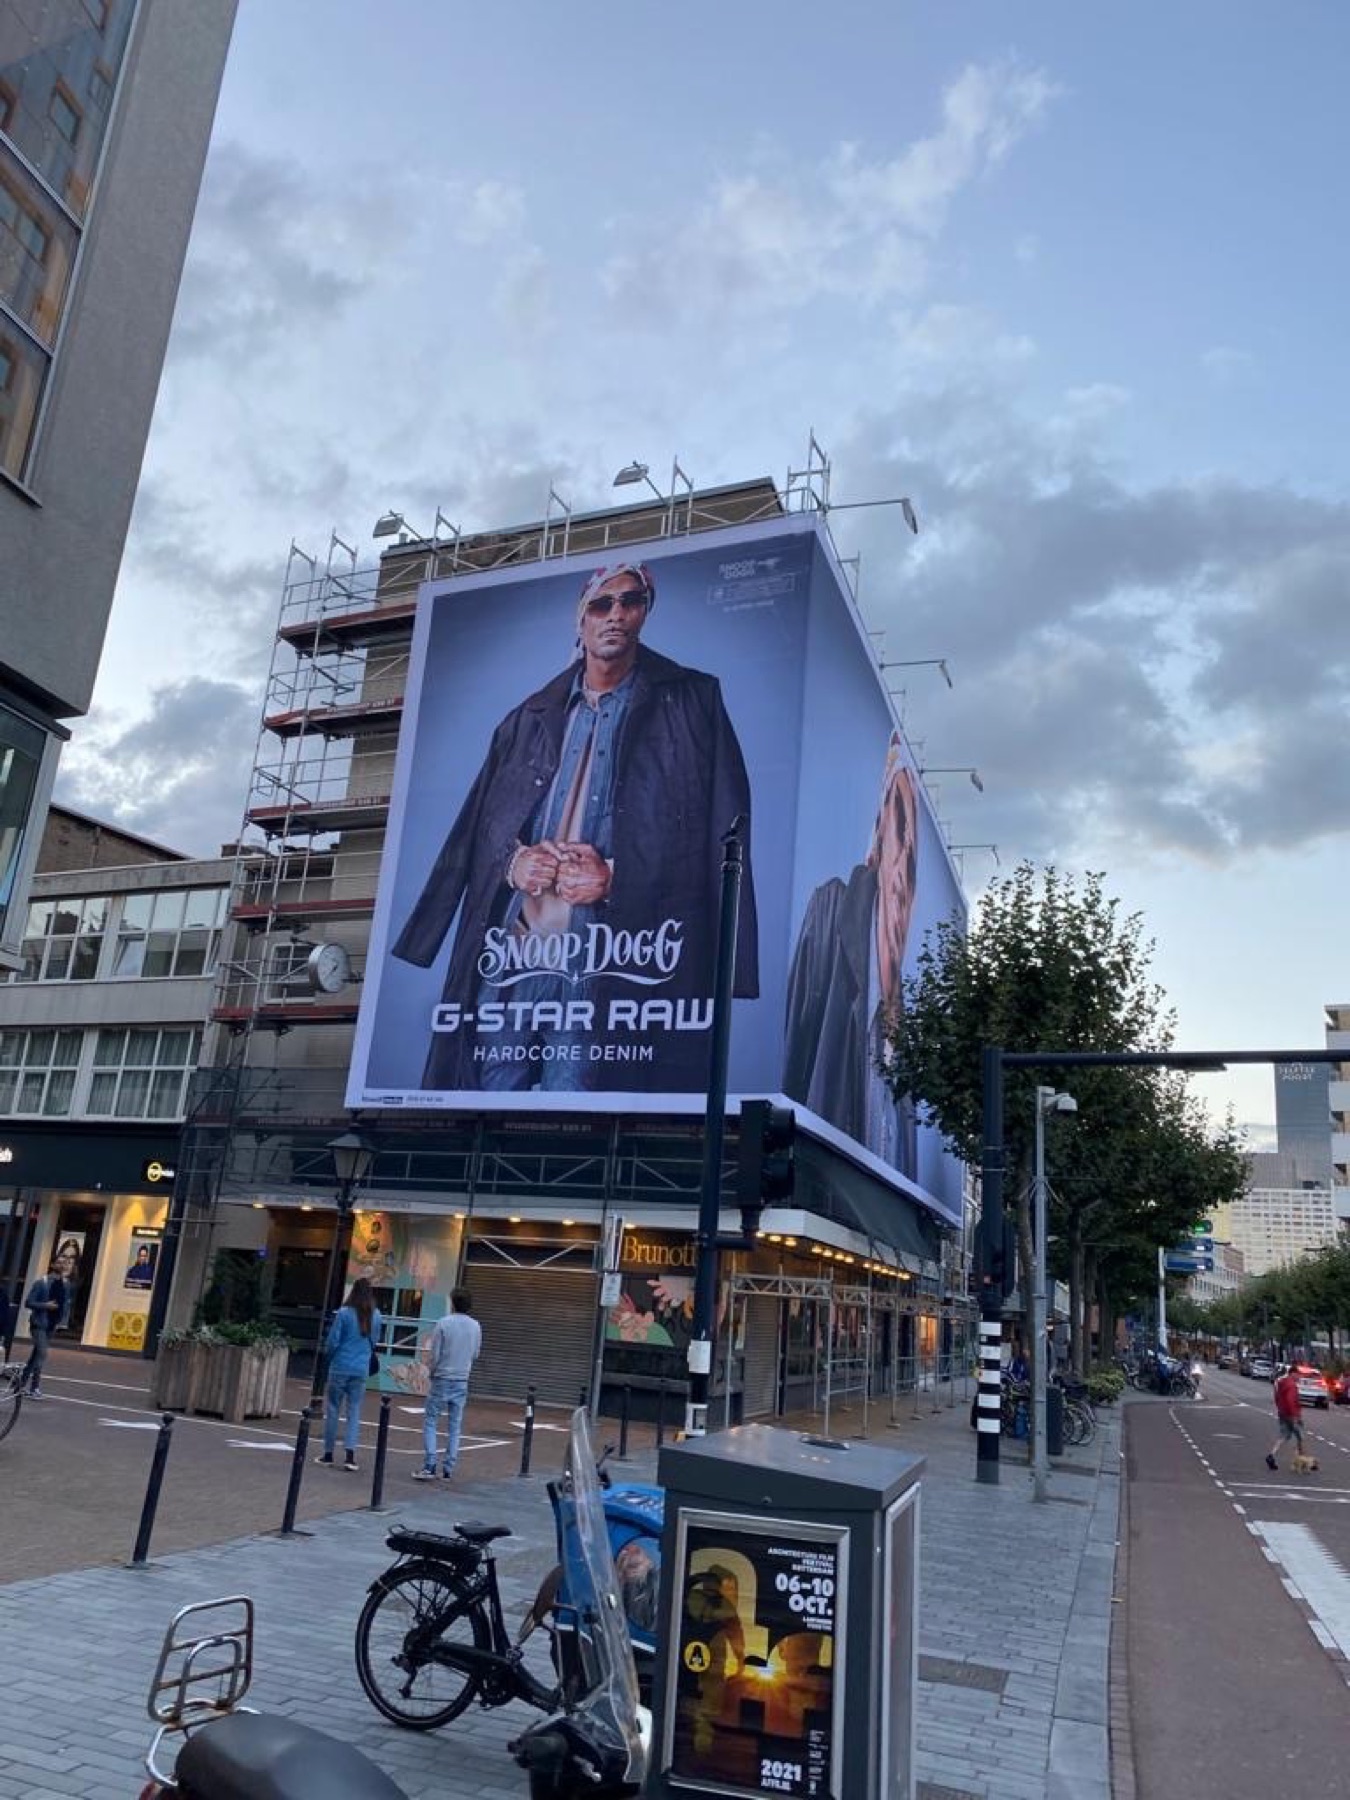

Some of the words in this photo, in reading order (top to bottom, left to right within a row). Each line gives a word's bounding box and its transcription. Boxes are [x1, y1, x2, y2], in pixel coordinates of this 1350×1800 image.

[478, 928, 581, 978] SNOOP
[583, 919, 684, 973] DOGG
[431, 1001, 595, 1033] G-STAR
[608, 998, 715, 1031] RAW
[474, 1046, 581, 1062] HARDCORE
[590, 1045, 653, 1061] DENIM
[789, 1594, 833, 1616] OCT.
[761, 1759, 802, 1782] 2021
